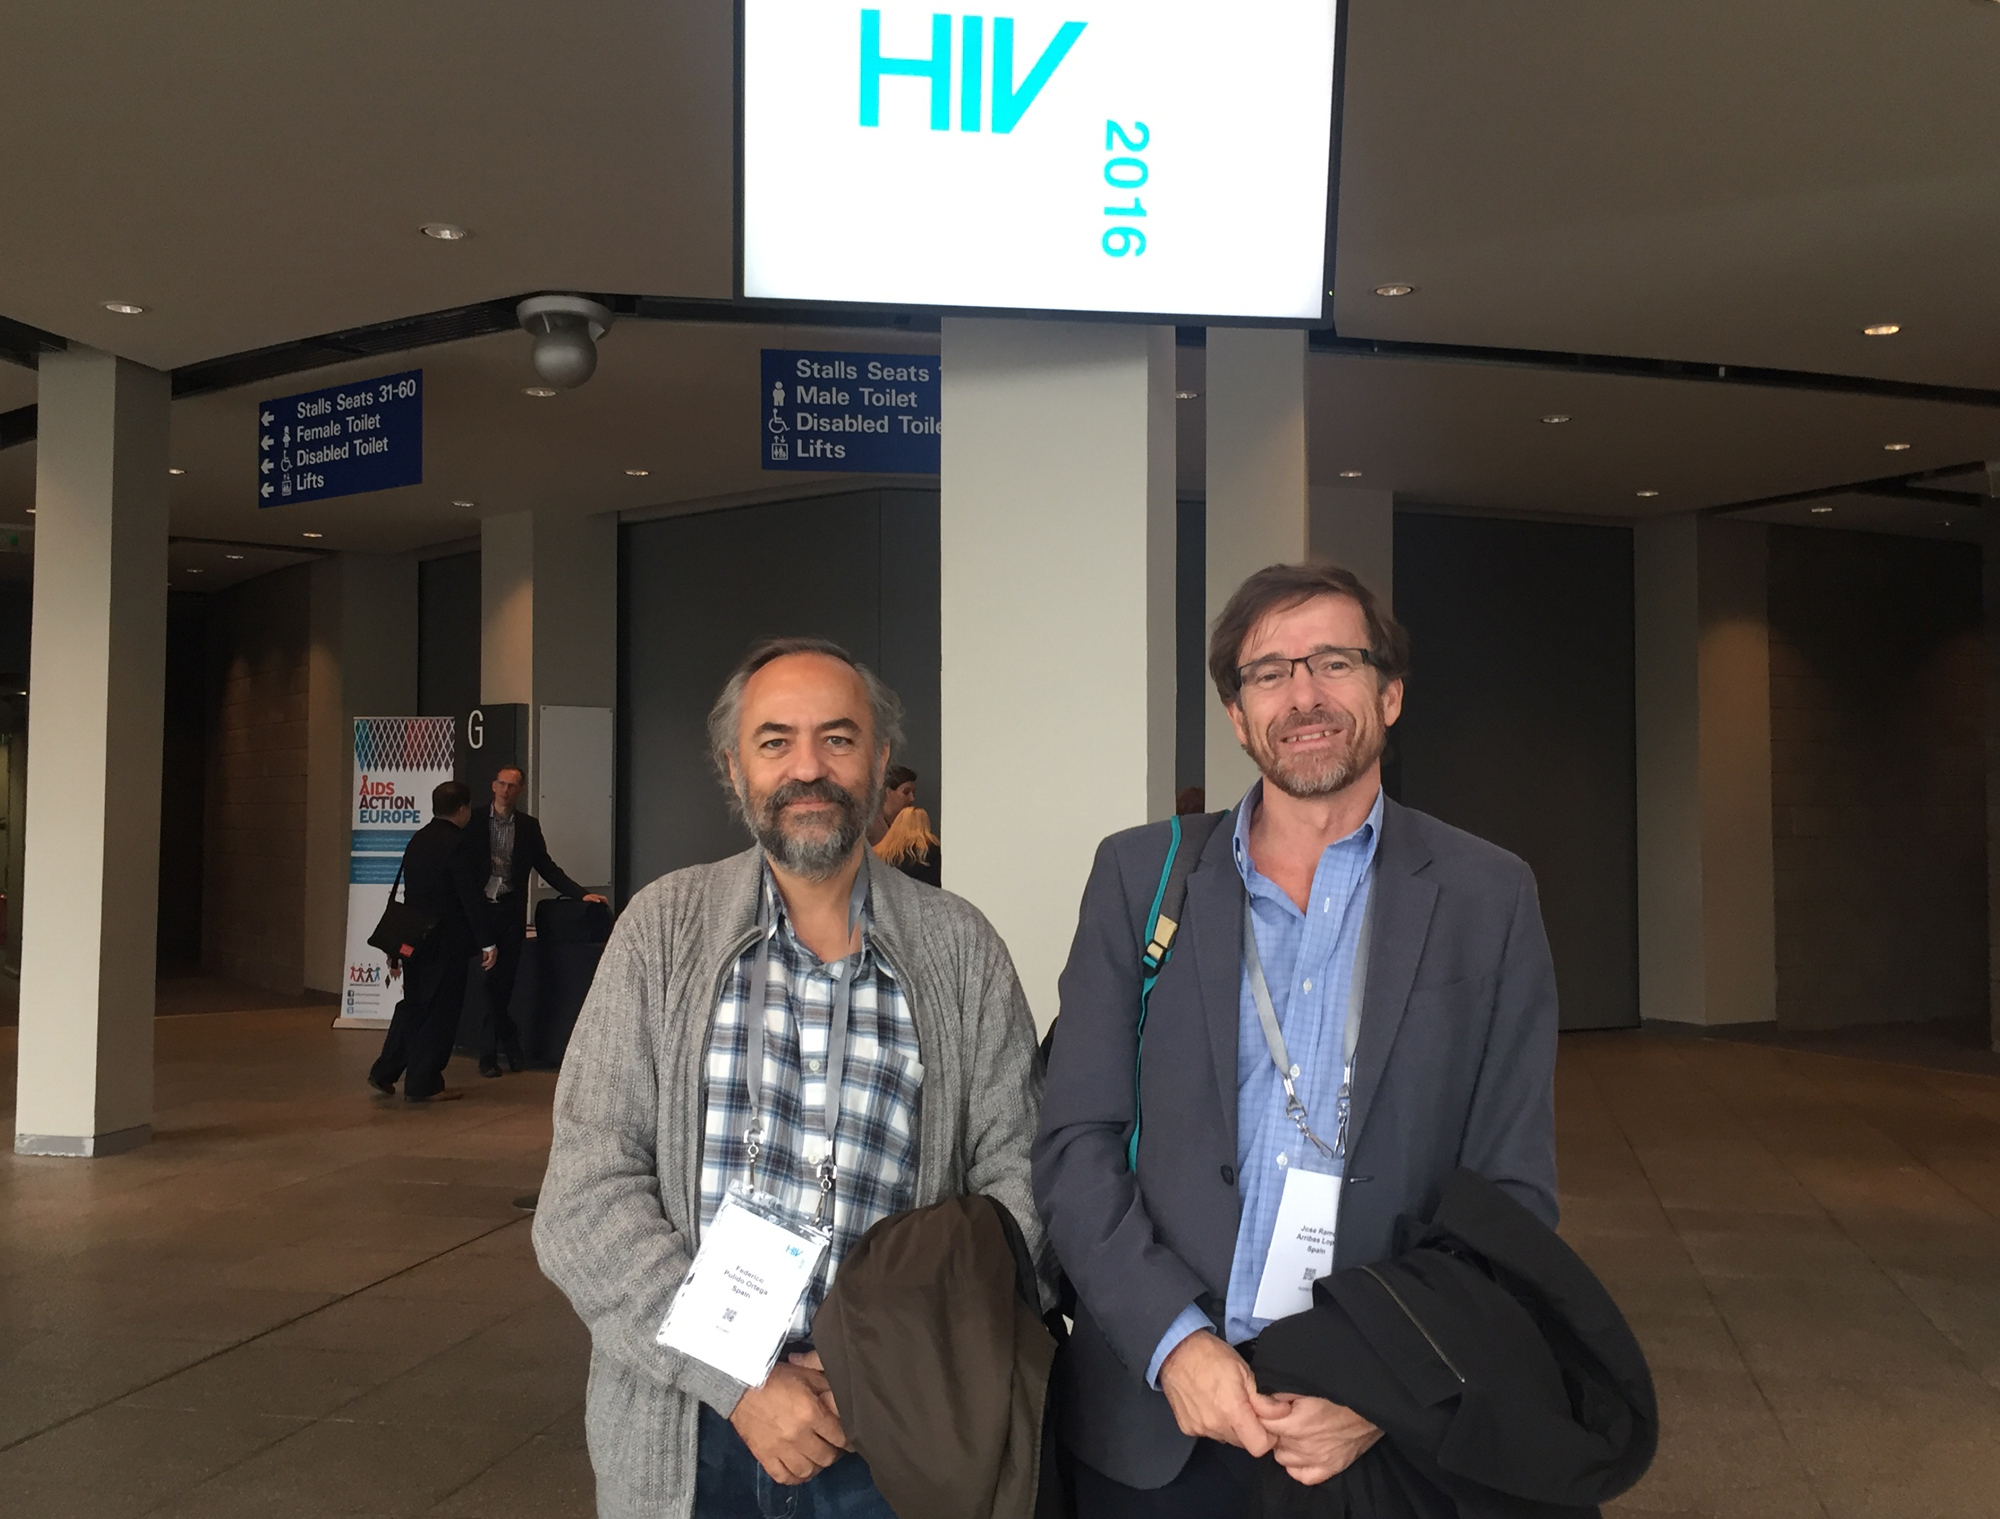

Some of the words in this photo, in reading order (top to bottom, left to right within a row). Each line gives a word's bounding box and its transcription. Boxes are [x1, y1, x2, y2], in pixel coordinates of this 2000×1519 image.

[859, 9, 1088, 134] HIV
[1102, 119, 1150, 258] 2016
[796, 359, 858, 380] Stalls
[867, 361, 930, 382] Seats
[297, 398, 332, 419] Stalls
[336, 390, 373, 411] Seats
[378, 379, 416, 403] 31-60
[796, 385, 850, 406] Male
[859, 387, 918, 408] Toilet
[297, 420, 341, 442] Female
[346, 413, 381, 433] Toilet
[796, 412, 889, 433] Disabled
[297, 442, 349, 466] Disabled
[353, 436, 389, 456] Toilet
[797, 438, 846, 459] Lifts
[297, 472, 325, 491] Lifts
[468, 710, 483, 749] G
[359, 775, 395, 796] AIDS
[359, 794, 415, 810] ACTION
[360, 810, 421, 824] EUROPE
[786, 1244, 804, 1257] HIV
[1307, 1245, 1326, 1254] Spain
[724, 1269, 745, 1284] Pulido
[746, 1280, 768, 1295] Ortega
[736, 1265, 764, 1284] Federico
[732, 1285, 751, 1299] Spain
